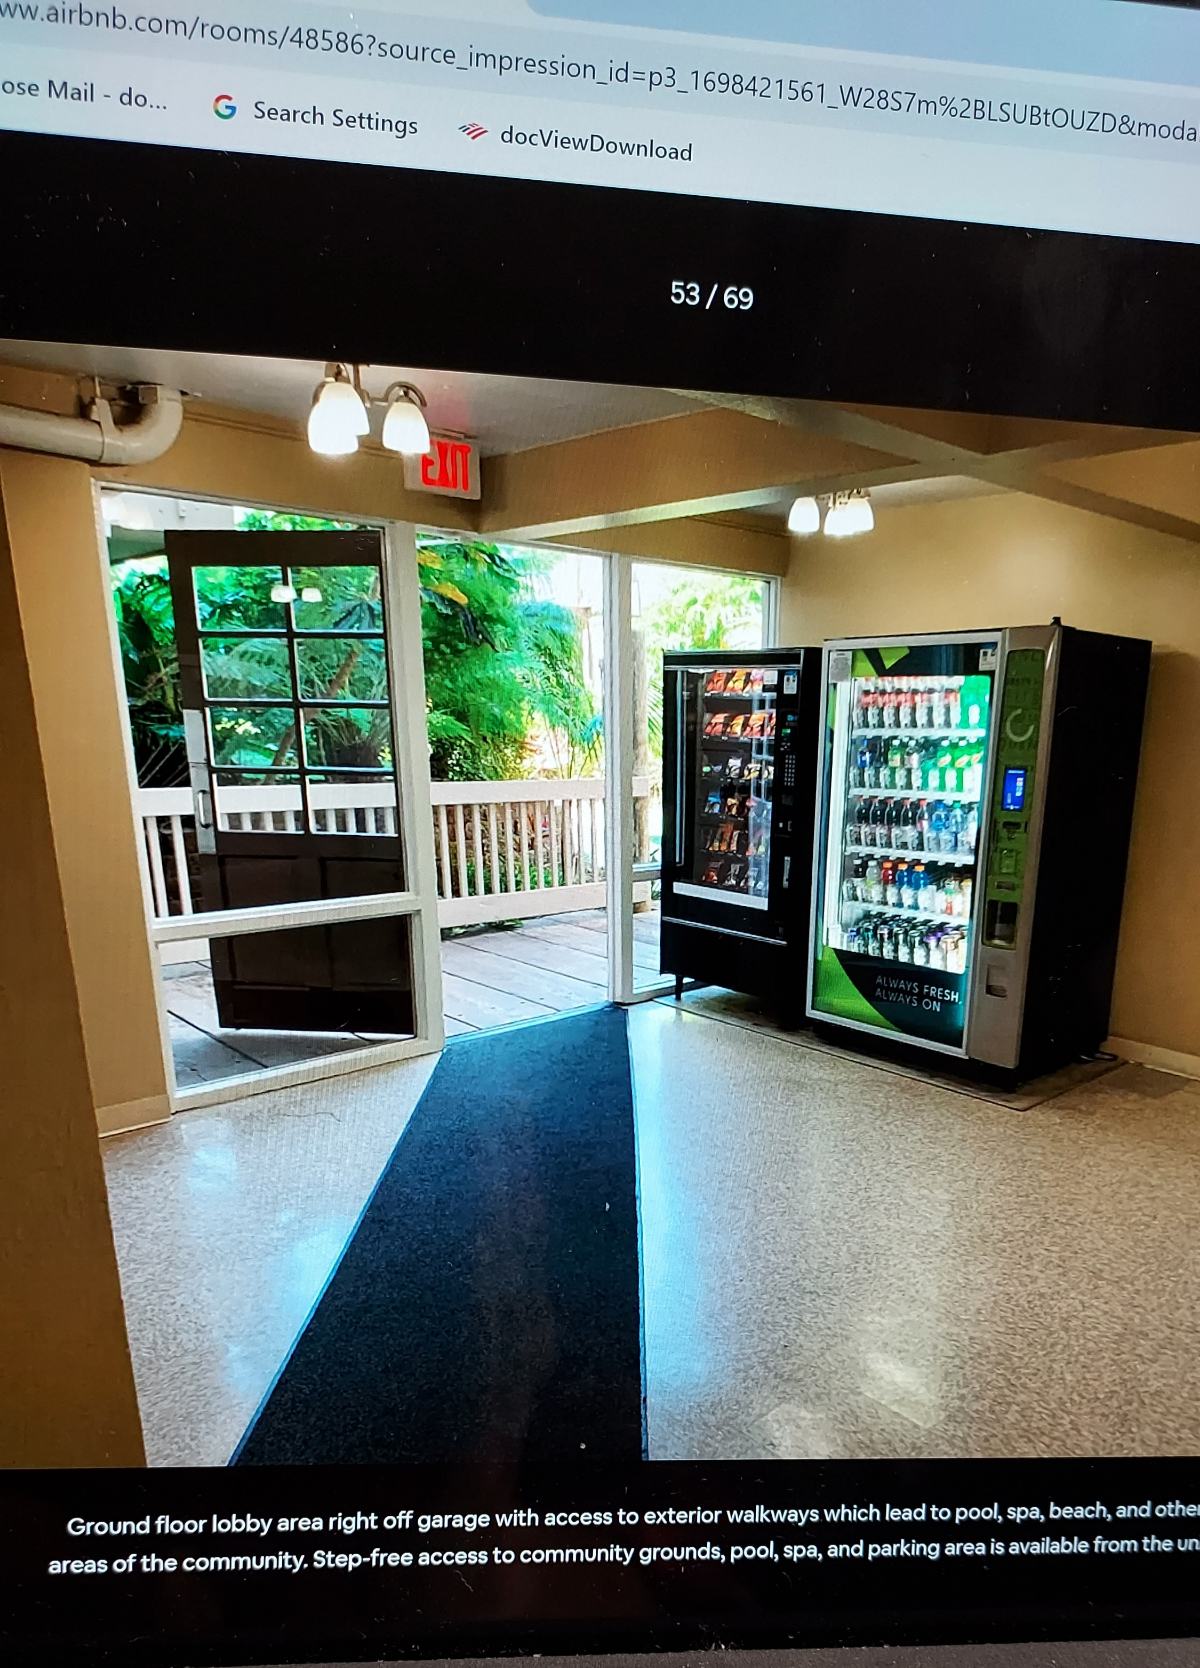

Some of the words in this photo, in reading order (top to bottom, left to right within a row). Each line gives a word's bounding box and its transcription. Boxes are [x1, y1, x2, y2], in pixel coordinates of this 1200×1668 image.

[1, 80, 40, 97] ose
[48, 79, 95, 102] Mail
[254, 101, 325, 126] Search
[332, 109, 418, 139] Settings
[501, 125, 693, 162] docViewDownload
[421, 439, 471, 492] EXIT
[875, 988, 918, 1007] ALWAYS
[922, 999, 941, 1012] ON
[876, 975, 919, 994] ALWAYS
[66, 1515, 151, 1536] Ground
[154, 1514, 208, 1534] floor
[212, 1513, 273, 1537] lobby
[276, 1517, 324, 1532] area
[328, 1510, 379, 1535] right
[383, 1509, 415, 1530] off
[416, 1512, 491, 1533] garage
[494, 1507, 539, 1527] with
[544, 1511, 613, 1526] access
[616, 1508, 640, 1525] to
[643, 1506, 723, 1525] exterior
[726, 1504, 820, 1527] walkways
[823, 1503, 881, 1522] which
[885, 1502, 926, 1521] lead
[929, 1504, 952, 1521] to
[955, 1502, 1003, 1524] pool,
[1006, 1506, 1045, 1524] spa,
[1049, 1500, 1112, 1522] beach,
[1115, 1499, 1153, 1518] and
[48, 1559, 109, 1574] areas
[112, 1553, 139, 1573] of
[140, 1552, 178, 1572] the
[182, 1550, 309, 1574] community.
[313, 1547, 414, 1572] Step-free
[417, 1550, 489, 1566] access
[492, 1546, 516, 1564] to
[519, 1543, 635, 1566] community
[638, 1541, 726, 1565] grounds,
[730, 1540, 779, 1564] pool,
[783, 1544, 823, 1563] spa,
[827, 1539, 864, 1558] and
[867, 1538, 940, 1561] parking
[944, 1542, 986, 1556] area
[990, 1538, 1005, 1555] is
[1008, 1536, 1091, 1556] available
[1093, 1535, 1140, 1554] from
[1141, 1534, 1175, 1552] the
[1177, 1537, 1200, 1551] un
